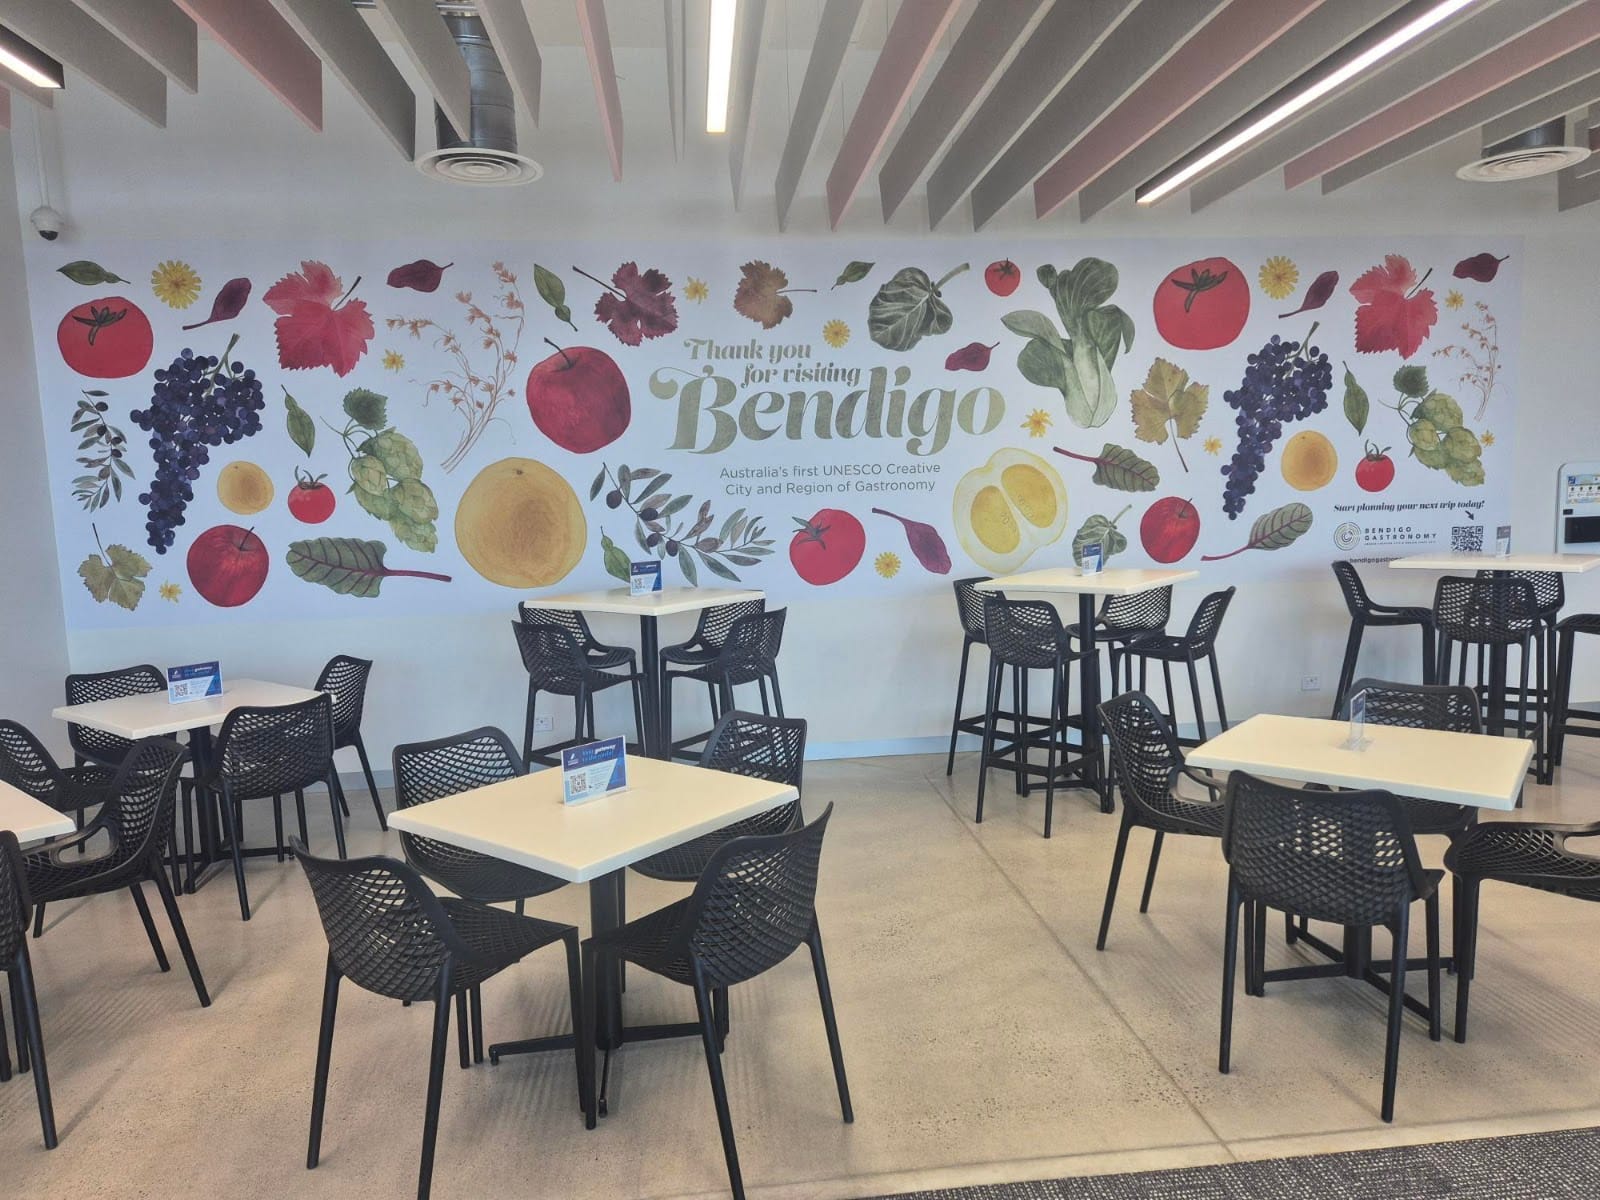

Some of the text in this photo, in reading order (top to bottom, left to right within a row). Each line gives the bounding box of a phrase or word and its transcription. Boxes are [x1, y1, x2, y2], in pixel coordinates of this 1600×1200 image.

[683, 338, 812, 364] Thank you
[740, 361, 861, 389] for visiting
[649, 364, 1006, 456] Bendigo
[719, 462, 941, 480] Australia's first UNESCO Creative
[725, 478, 936, 497] City and Region of Gastronomy
[1333, 499, 1485, 514] Start planning your next trip today!
[1364, 533, 1437, 541] GASTRONOMY
